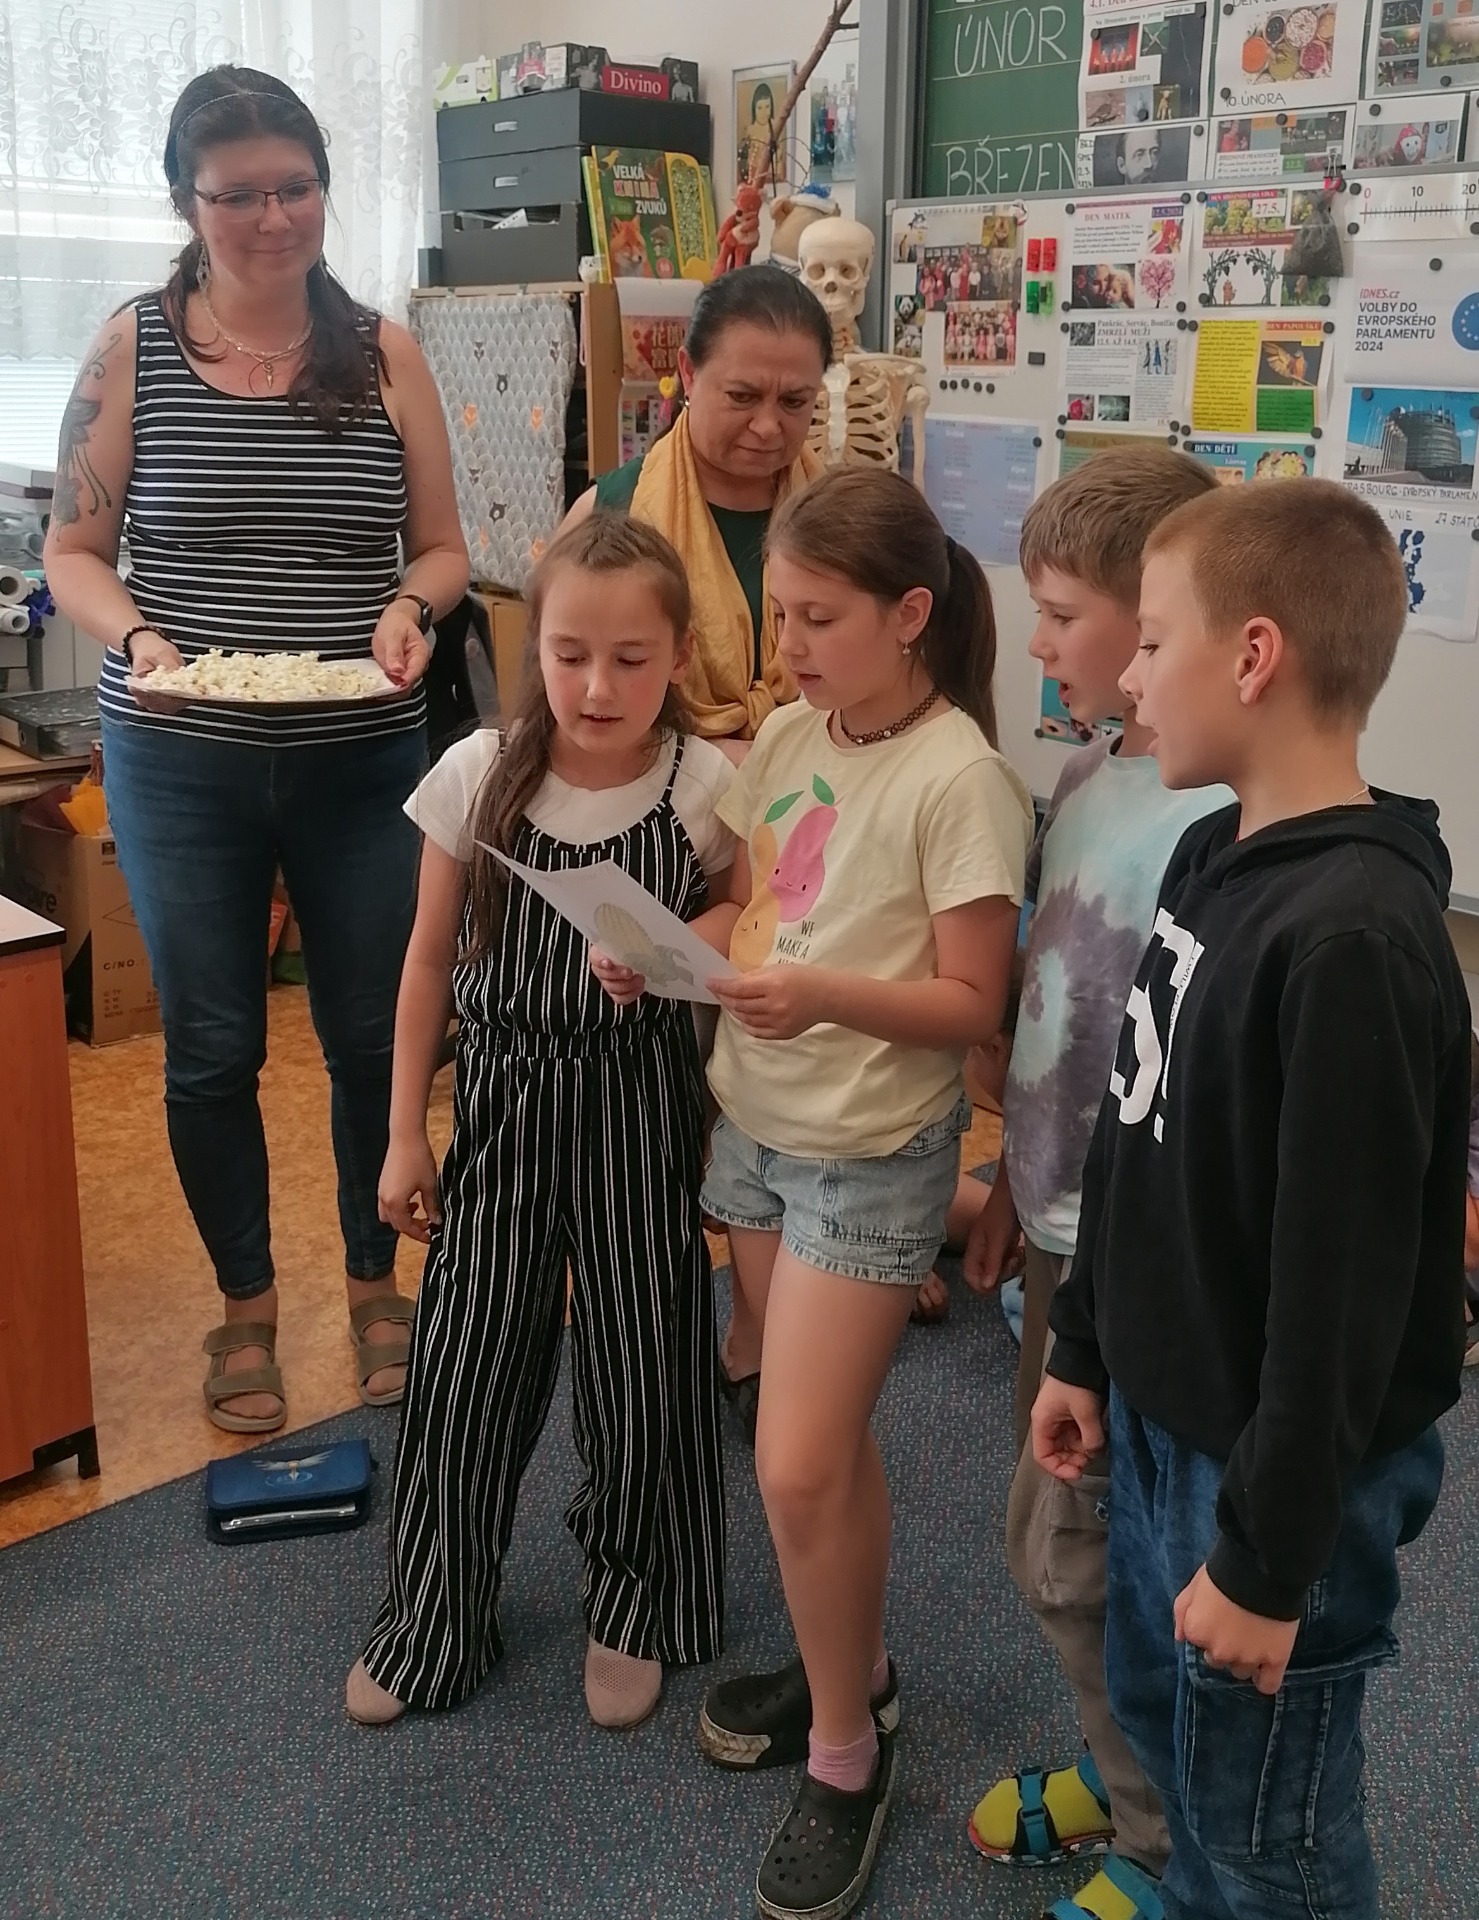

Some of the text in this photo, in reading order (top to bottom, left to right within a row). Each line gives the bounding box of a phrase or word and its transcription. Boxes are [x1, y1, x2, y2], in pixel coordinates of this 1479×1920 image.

[954, 6, 1067, 77] ÚNOR
[610, 70, 662, 95] Divino
[1241, 91, 1286, 106] ÚNORA
[613, 163, 645, 180] VELKÁ
[946, 135, 1078, 197] BŘEZEN
[1364, 188, 1371, 199] 0
[1411, 186, 1424, 197] 10
[1462, 184, 1476, 195] 20
[635, 198, 668, 215] ZVUKŮ
[1085, 212, 1131, 222] DEN MATEK
[1359, 302, 1417, 312] VOLBY DO
[1357, 313, 1437, 326] EVROPSKÉHO
[1355, 328, 1435, 339] PARLAMENTU
[1354, 341, 1383, 351] 2024
[1194, 443, 1235, 454] DEN DĚTÍ
[1342, 481, 1398, 497] RASBOURG
[1440, 489, 1479, 500] PARLAMEN
[1389, 508, 1413, 521] UNIE
[1434, 512, 1447, 524] 27
[801, 920, 815, 938] WE
[777, 935, 810, 959] MAKE A
